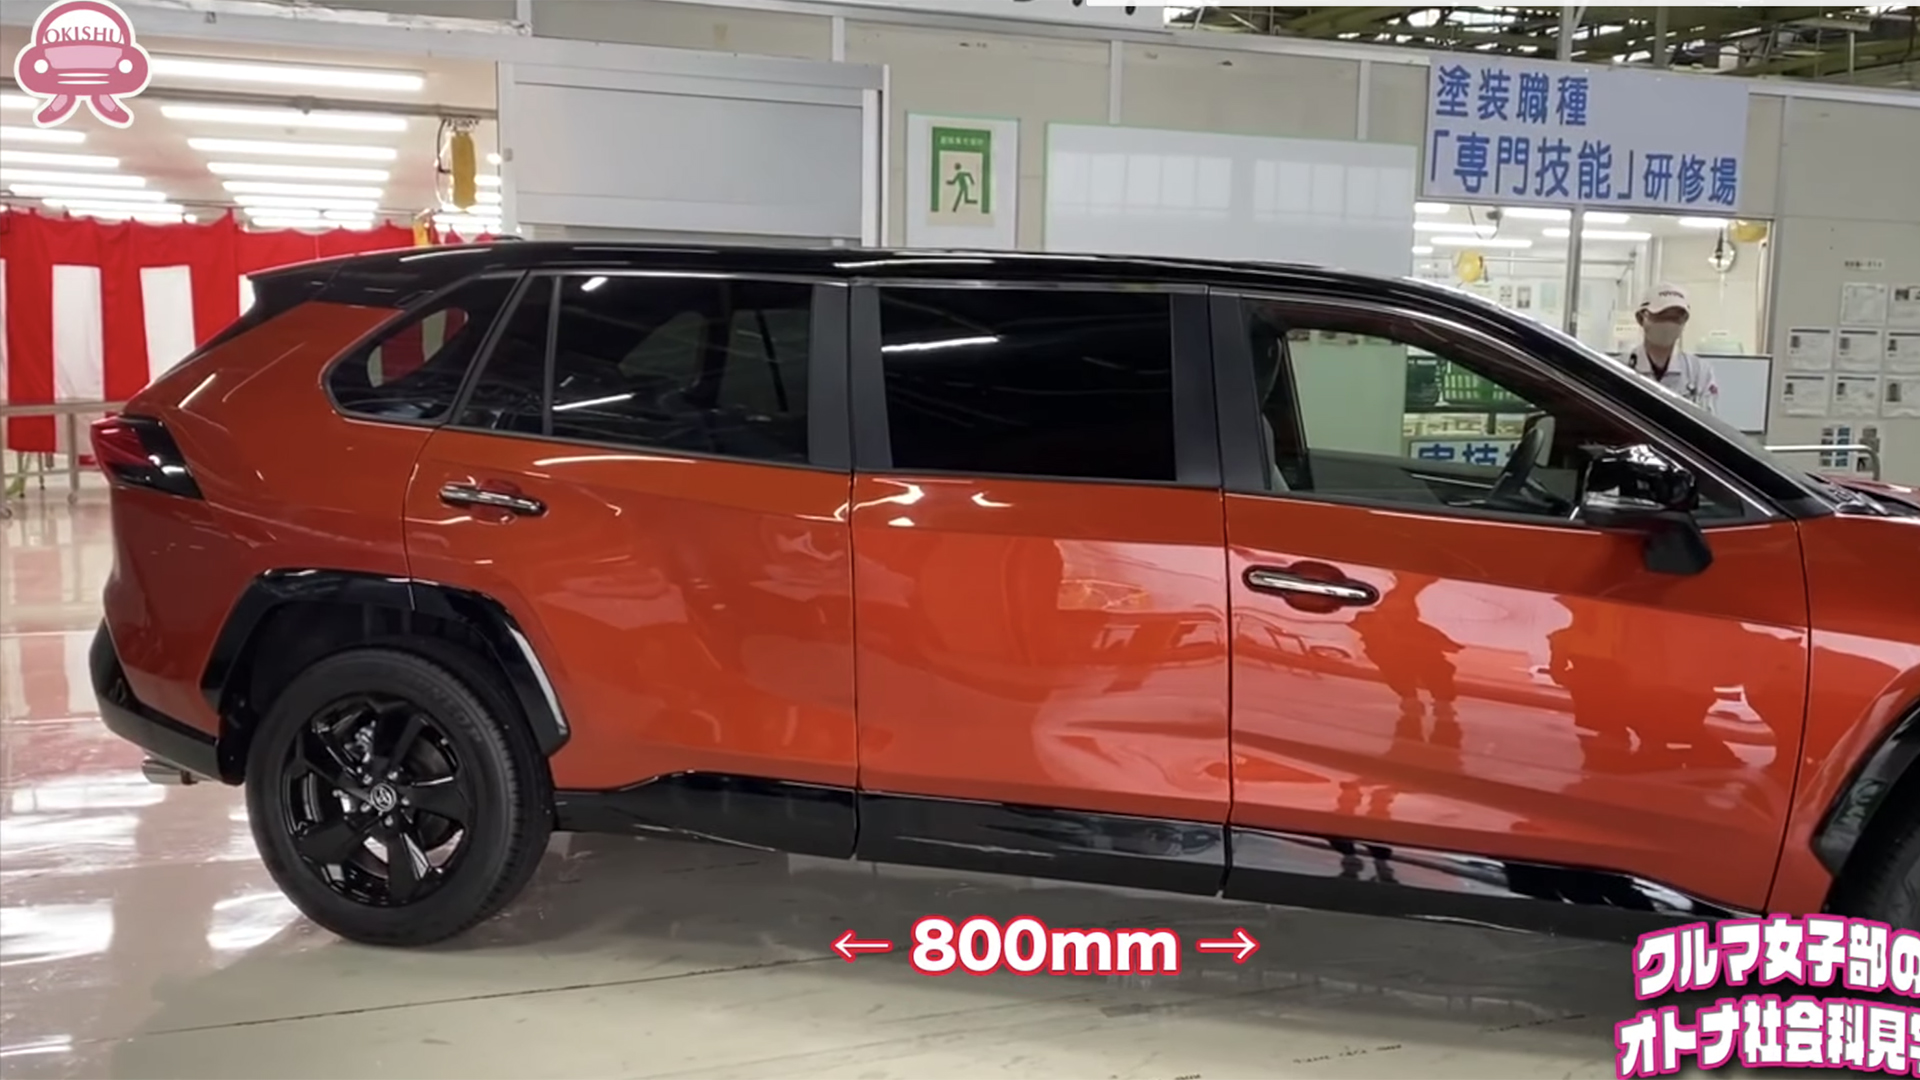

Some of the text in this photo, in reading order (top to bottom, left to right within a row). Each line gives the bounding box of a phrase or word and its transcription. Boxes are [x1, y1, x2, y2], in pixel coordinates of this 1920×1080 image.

[1436, 64, 1589, 127] 塗装職種
[1430, 129, 1739, 206] 「専門技能」研修場
